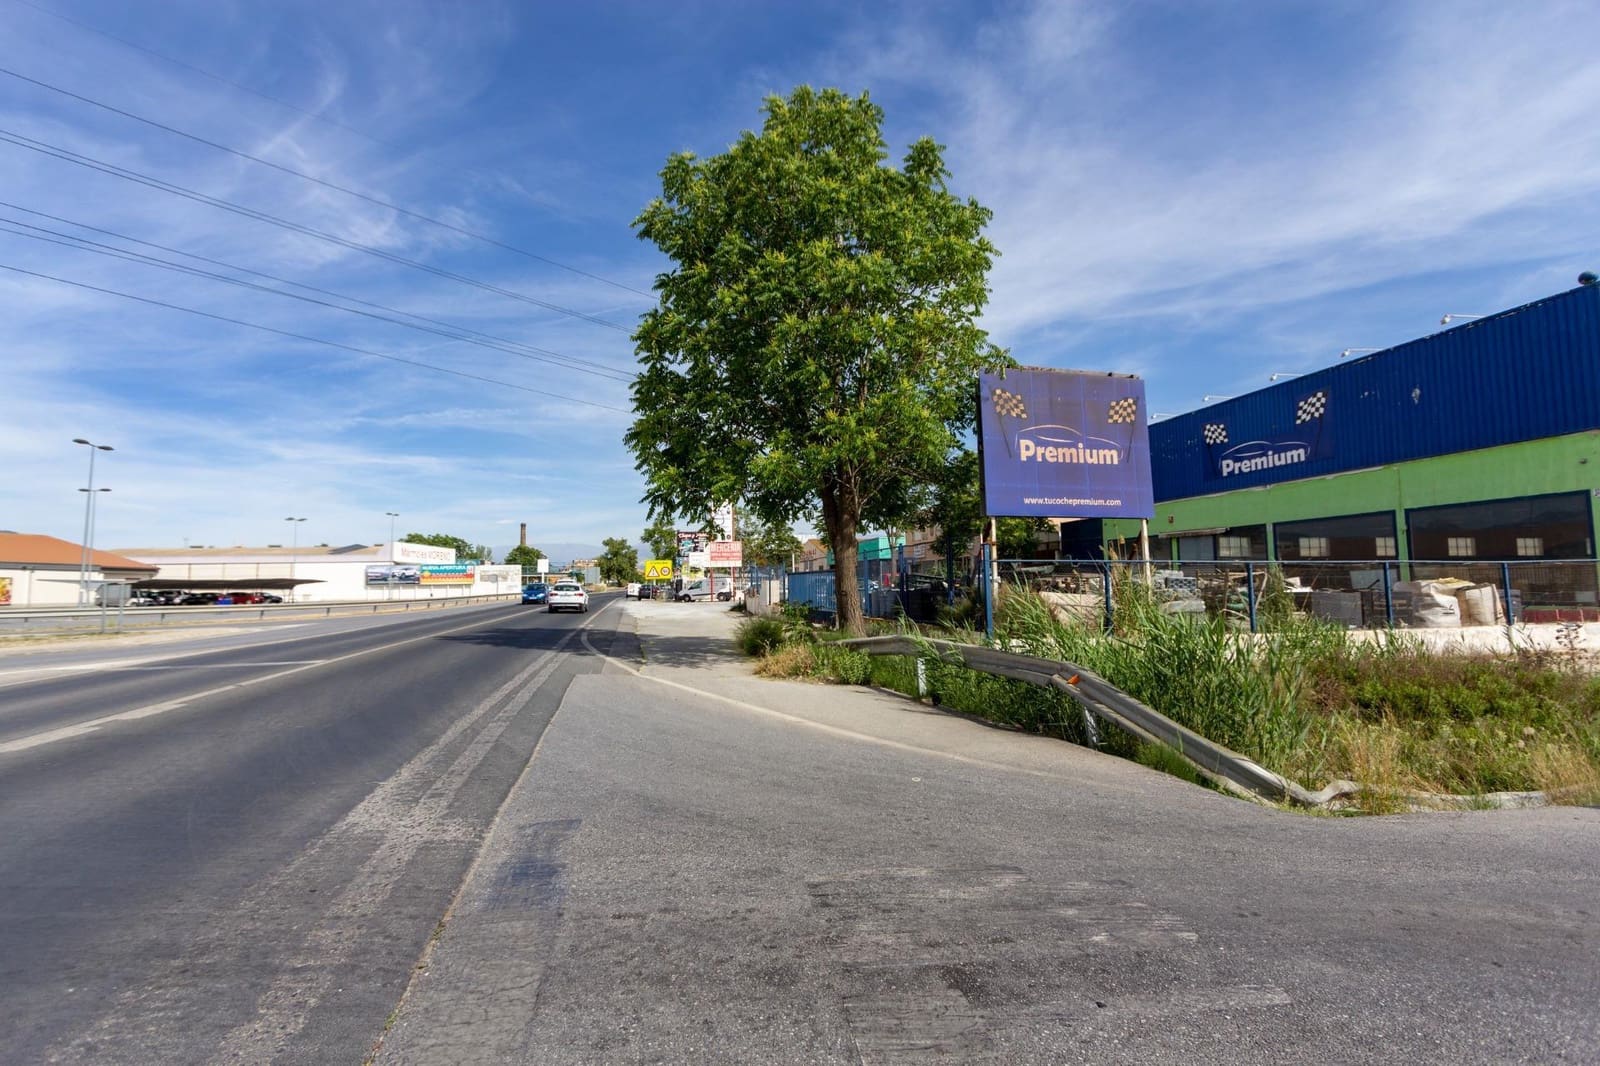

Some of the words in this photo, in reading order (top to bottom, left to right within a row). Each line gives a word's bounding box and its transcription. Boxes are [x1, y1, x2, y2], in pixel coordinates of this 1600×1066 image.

[1019, 439, 1119, 465] Premium
[1221, 448, 1306, 477] Premium
[1023, 497, 1122, 507] www.tucochepremium.com
